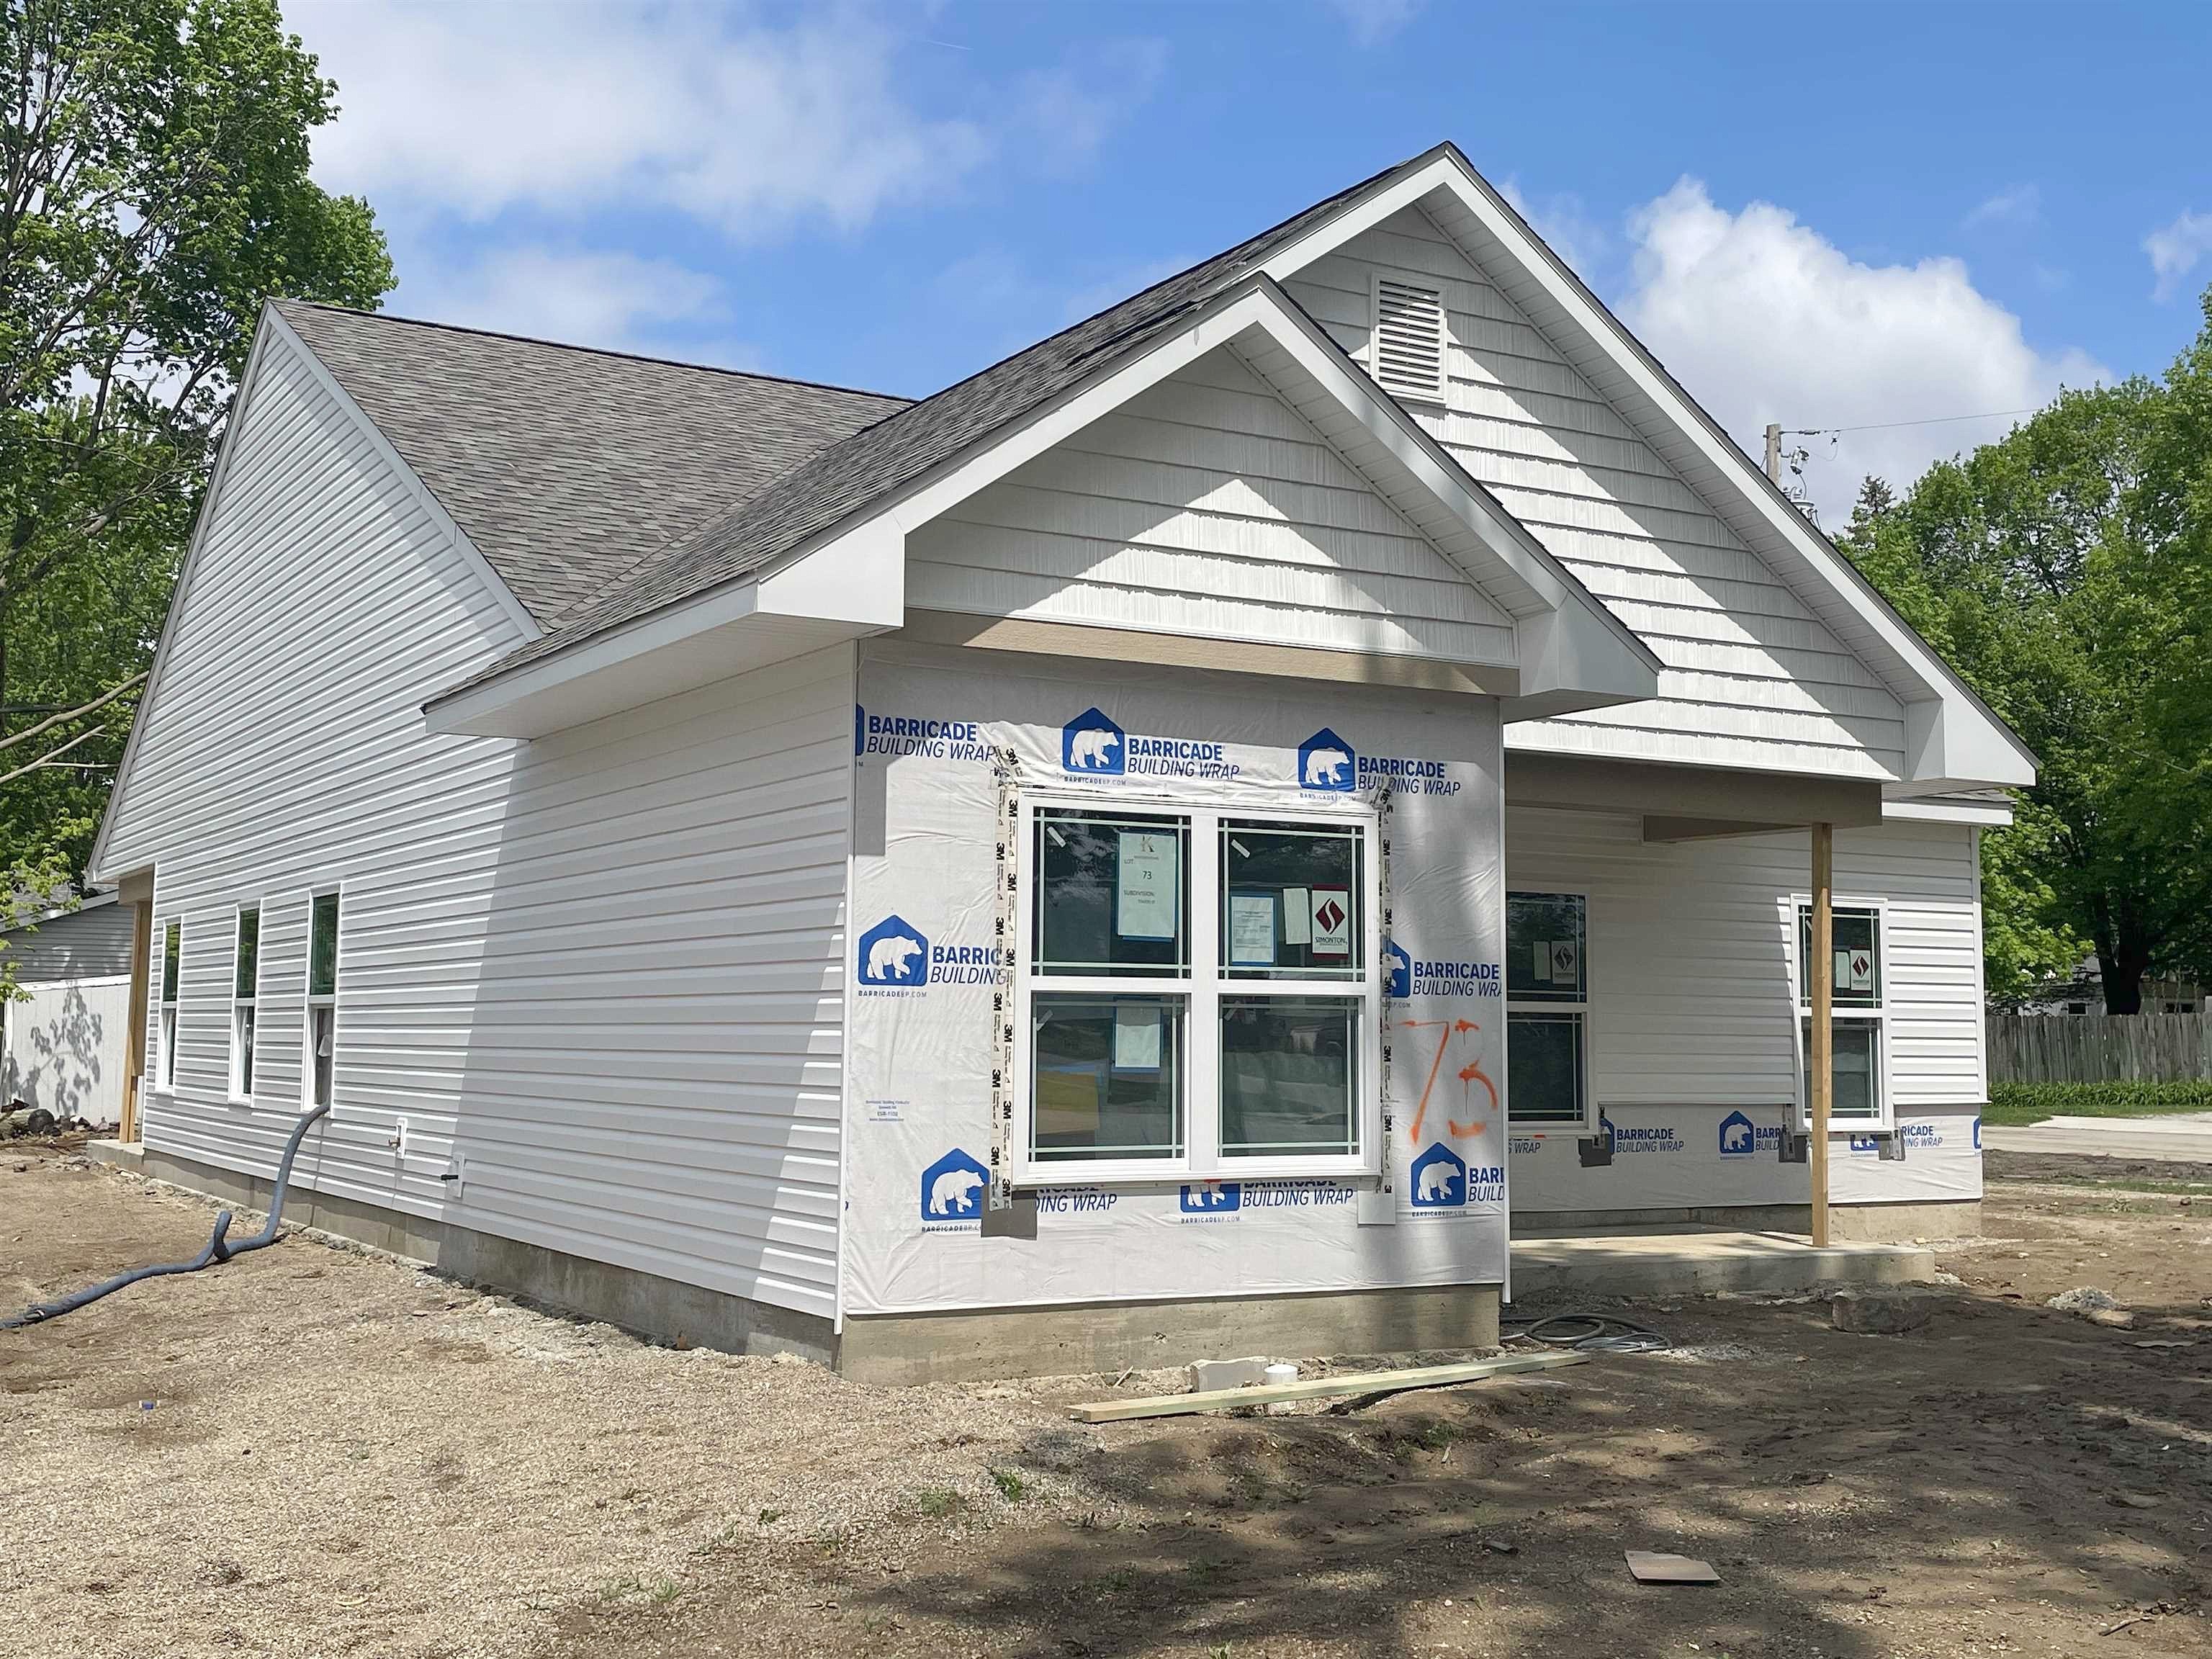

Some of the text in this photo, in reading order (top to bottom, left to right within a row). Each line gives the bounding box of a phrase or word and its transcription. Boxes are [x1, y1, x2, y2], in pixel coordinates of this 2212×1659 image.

[868, 715, 977, 742] BARRICADE
[867, 736, 995, 762] BUILDING WRAP
[1006, 748, 1019, 765] 3M
[1128, 738, 1223, 761] BARRICADE
[1128, 757, 1240, 780] BUILDING WRAP
[1358, 757, 1445, 778] BARRICADE
[1424, 780, 1461, 796] WRAP
[1008, 799, 1017, 817] 3M
[996, 842, 1004, 860] 3M
[1383, 839, 1390, 855] 3M
[1007, 873, 1017, 891] 3M
[1142, 870, 1153, 880] 73
[1385, 908, 1392, 925] 3M
[996, 917, 1004, 935] 3M
[932, 945, 1002, 966] BARRIC
[1006, 948, 1015, 966] 3M
[930, 966, 1007, 985] BUILDING
[1414, 961, 1499, 979] BARRICADE
[1413, 979, 1474, 997] BUILDING
[994, 992, 1002, 1011] 3M
[1004, 1024, 1012, 1043] 3M
[1384, 1045, 1391, 1062] 3M
[992, 1069, 1001, 1088] 3M
[1003, 1100, 1012, 1119] 3M
[1385, 1115, 1392, 1132] 3M
[1617, 1128, 1673, 1140] BARRICADE
[1921, 1137, 1943, 1147] WRAP
[991, 1146, 999, 1165] 3M
[1514, 1142, 1541, 1154] WRAP
[1616, 1141, 1684, 1153] BUILDING WRAP
[1002, 1178, 1011, 1197] 3M
[1074, 1194, 1118, 1211] WRAP
[1242, 1188, 1354, 1208] BUILDING WRAP
